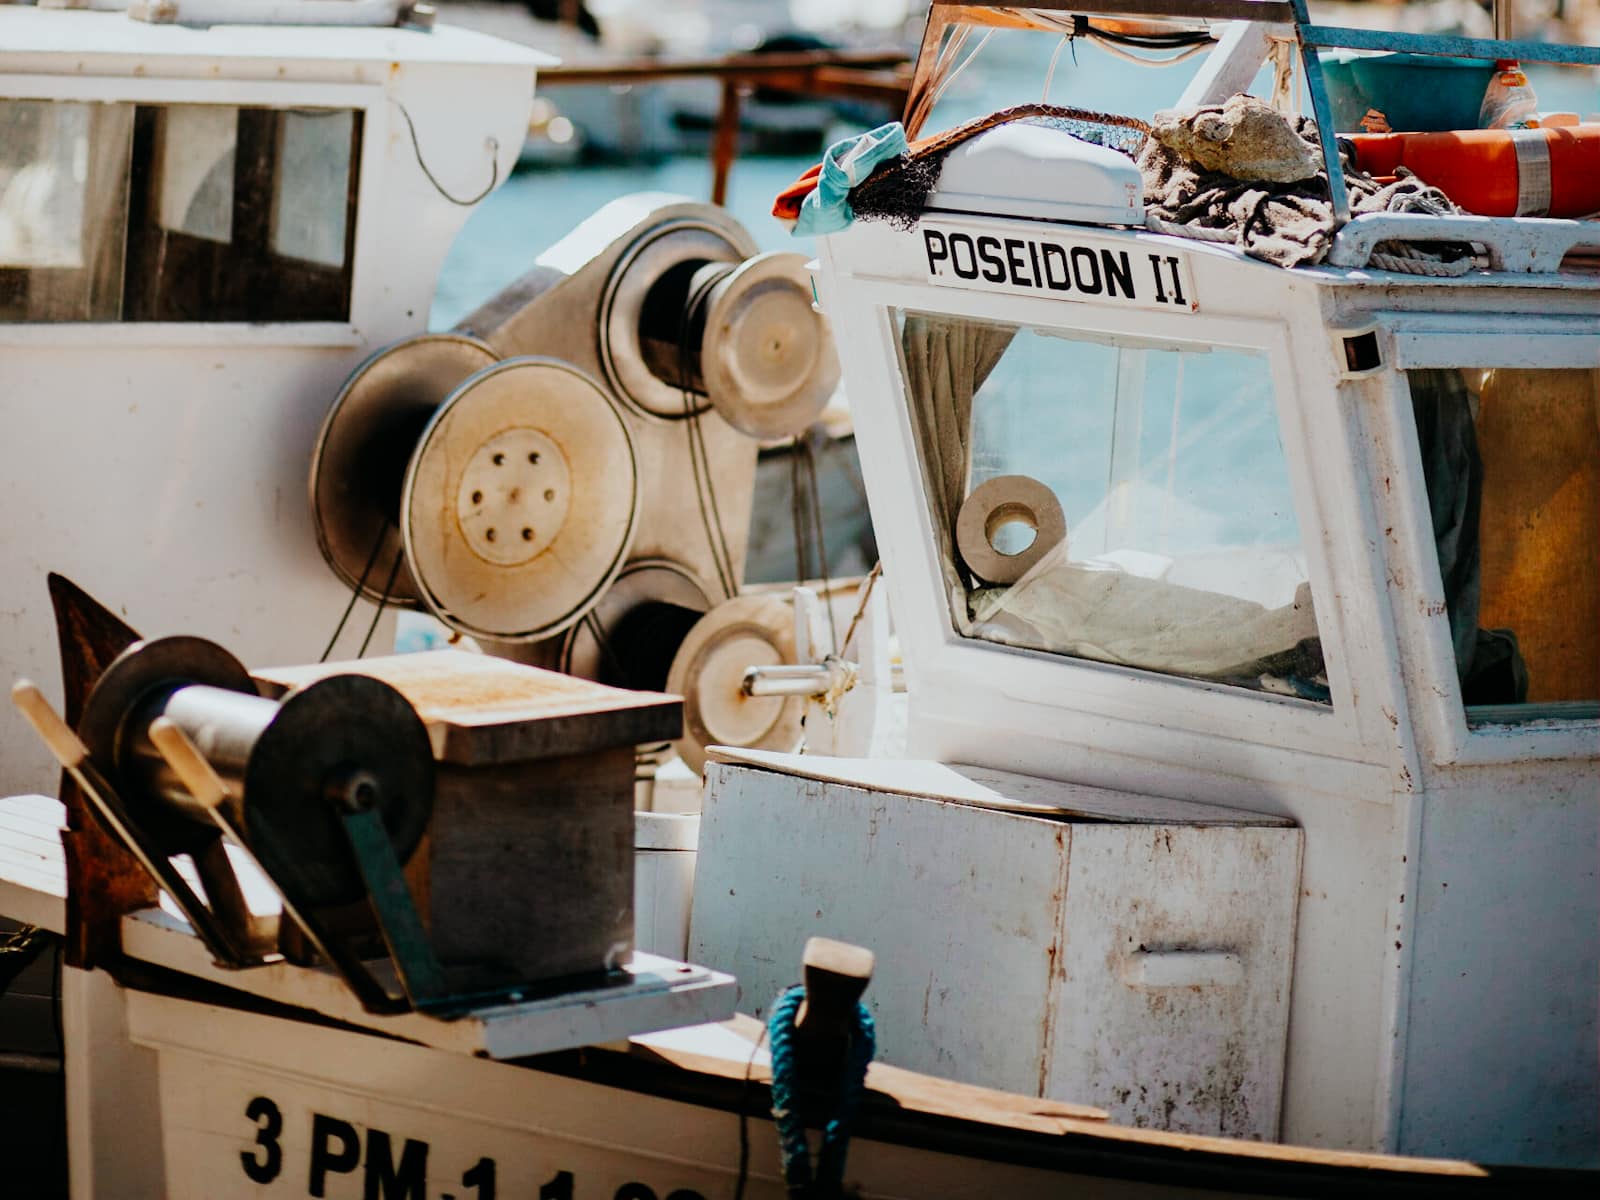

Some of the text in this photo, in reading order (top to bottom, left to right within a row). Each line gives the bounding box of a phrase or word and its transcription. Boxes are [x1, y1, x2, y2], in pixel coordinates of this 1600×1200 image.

[923, 229, 1187, 305] POSEIDON II
[240, 1096, 283, 1185] 3
